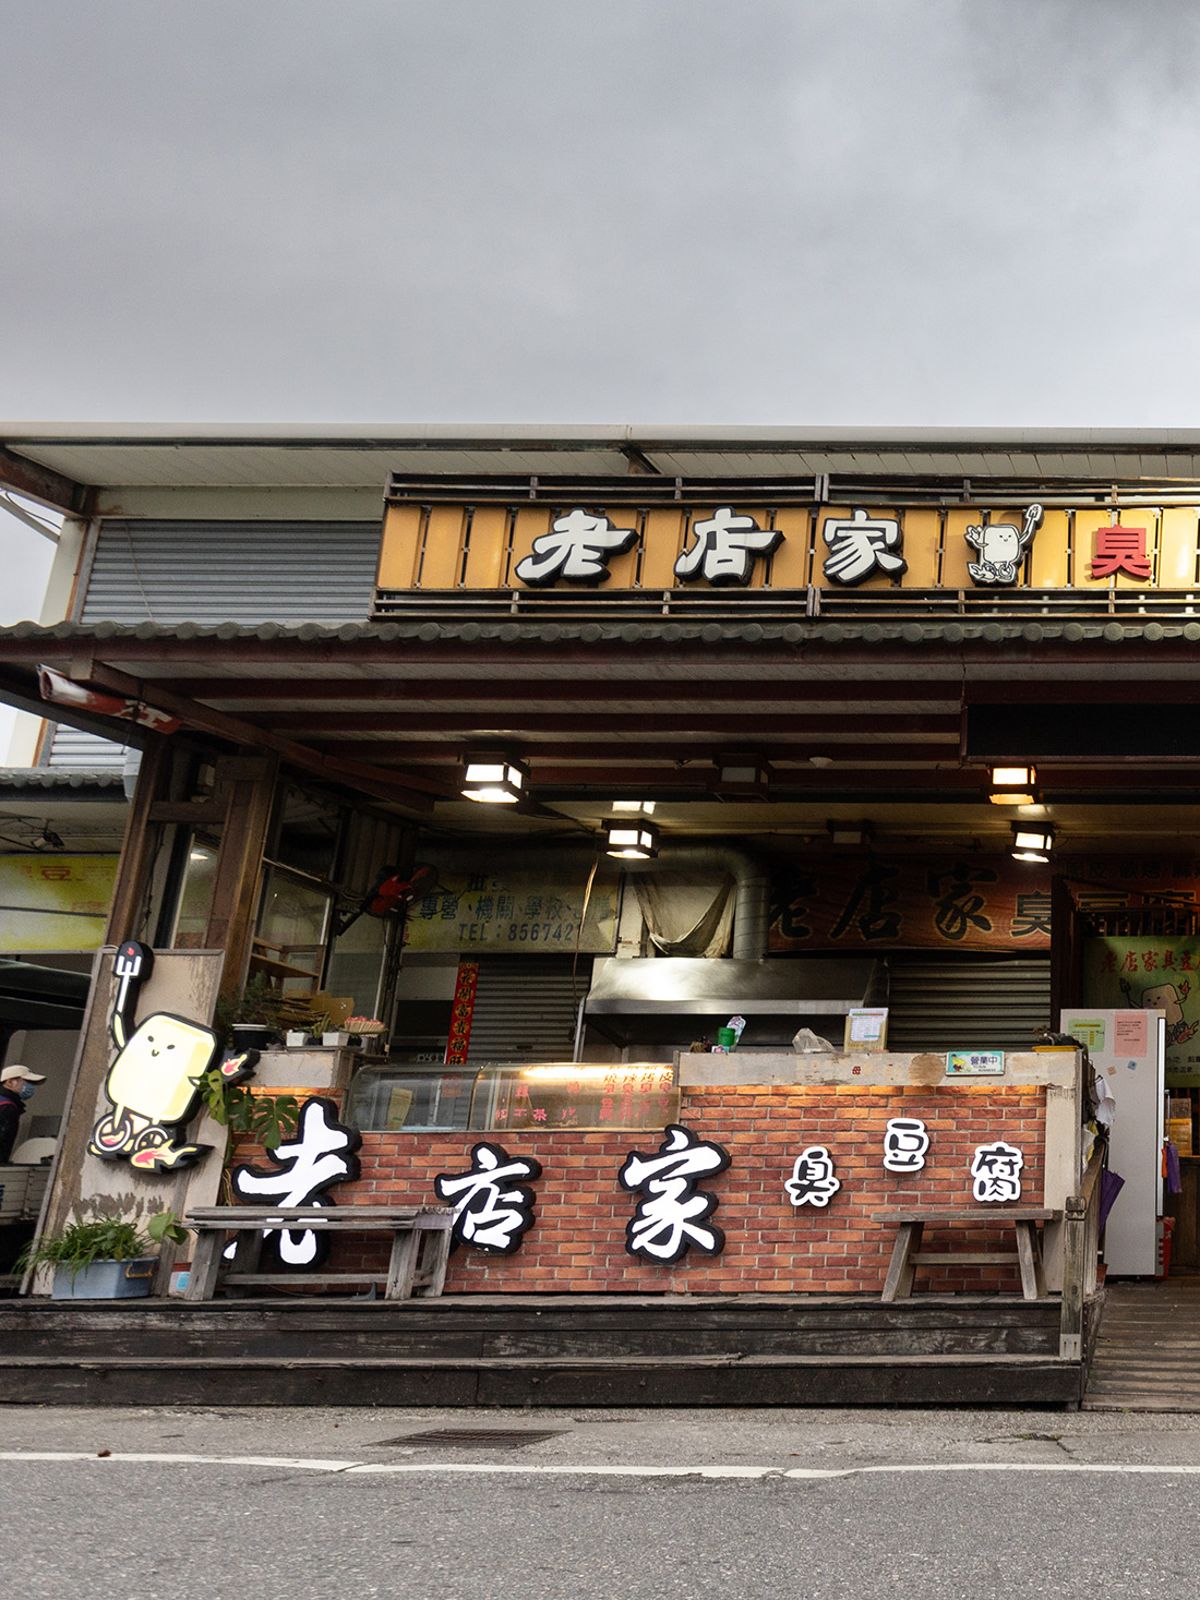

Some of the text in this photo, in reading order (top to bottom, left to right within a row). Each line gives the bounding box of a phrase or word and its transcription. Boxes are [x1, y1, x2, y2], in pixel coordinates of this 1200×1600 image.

[515, 507, 908, 587] 老店家
[224, 1099, 1024, 1266] 老店家 臭豆腐
